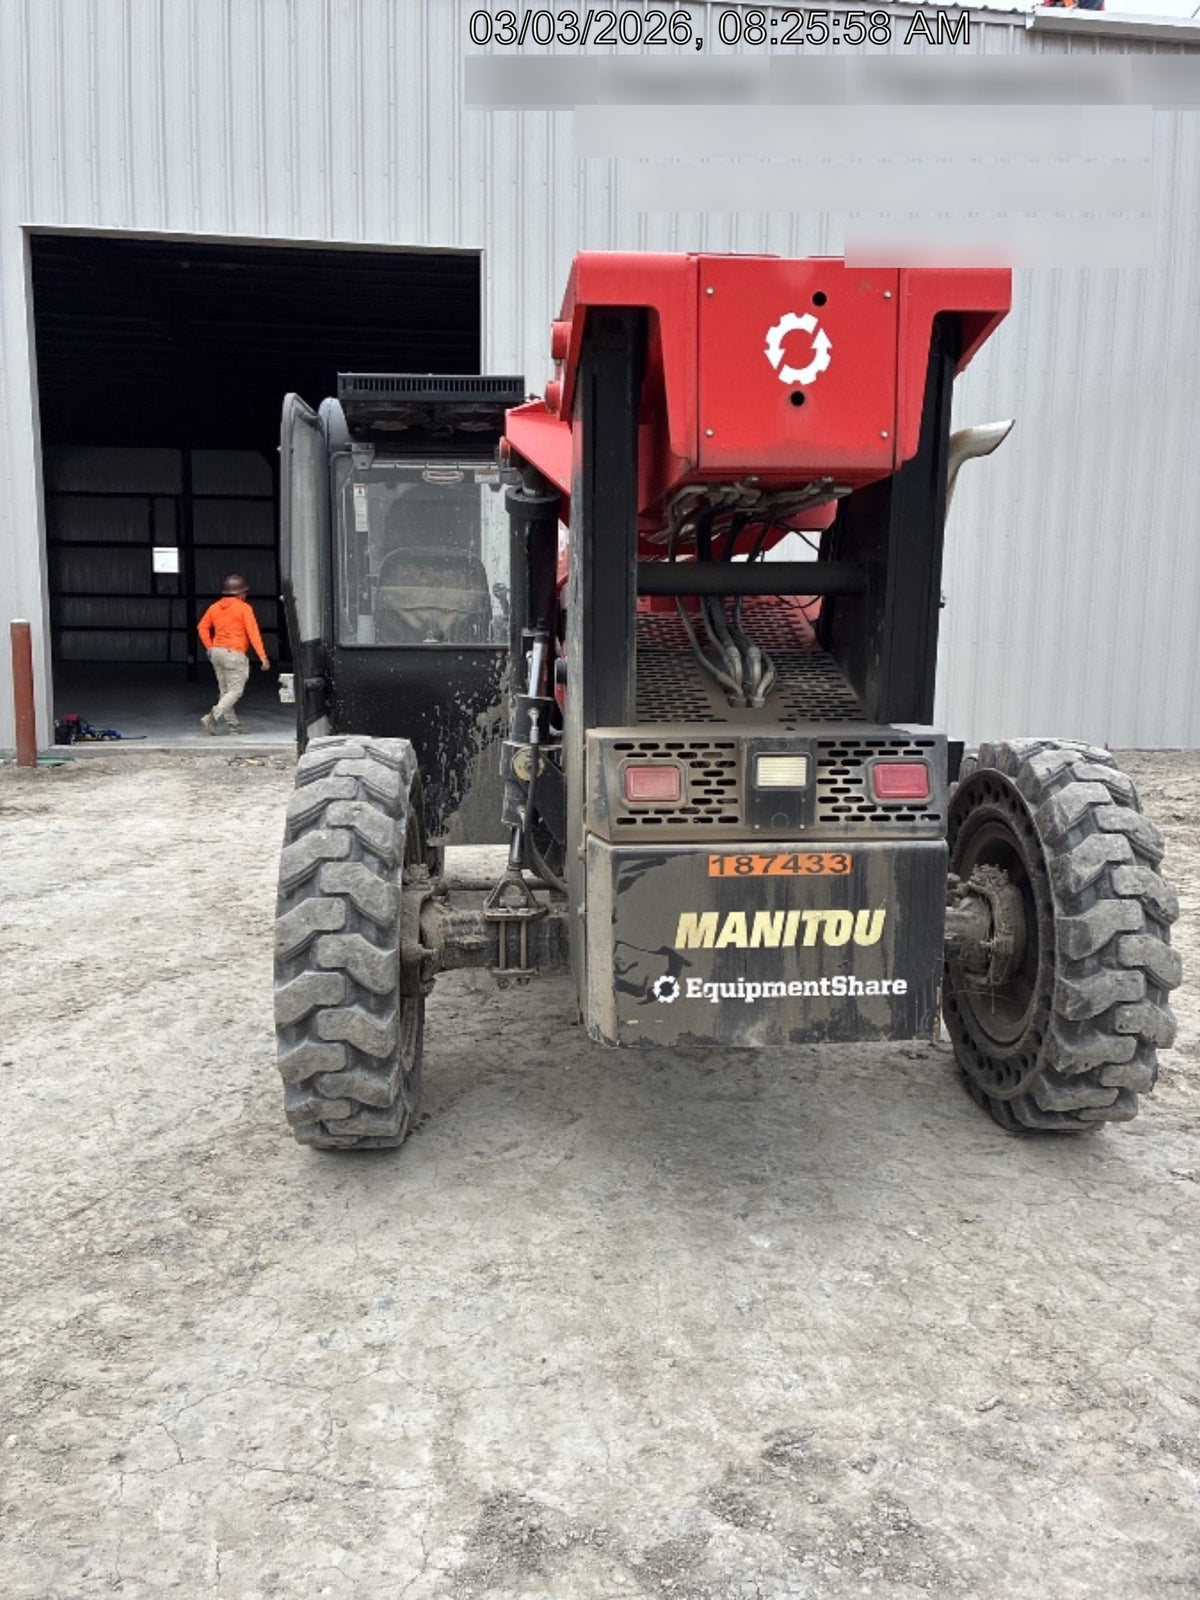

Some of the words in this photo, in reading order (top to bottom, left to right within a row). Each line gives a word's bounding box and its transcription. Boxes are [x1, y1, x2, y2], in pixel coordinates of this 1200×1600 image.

[712, 854, 849, 875] 187433
[675, 909, 886, 949] MANITOU
[685, 976, 908, 1003] EquipmentShare
